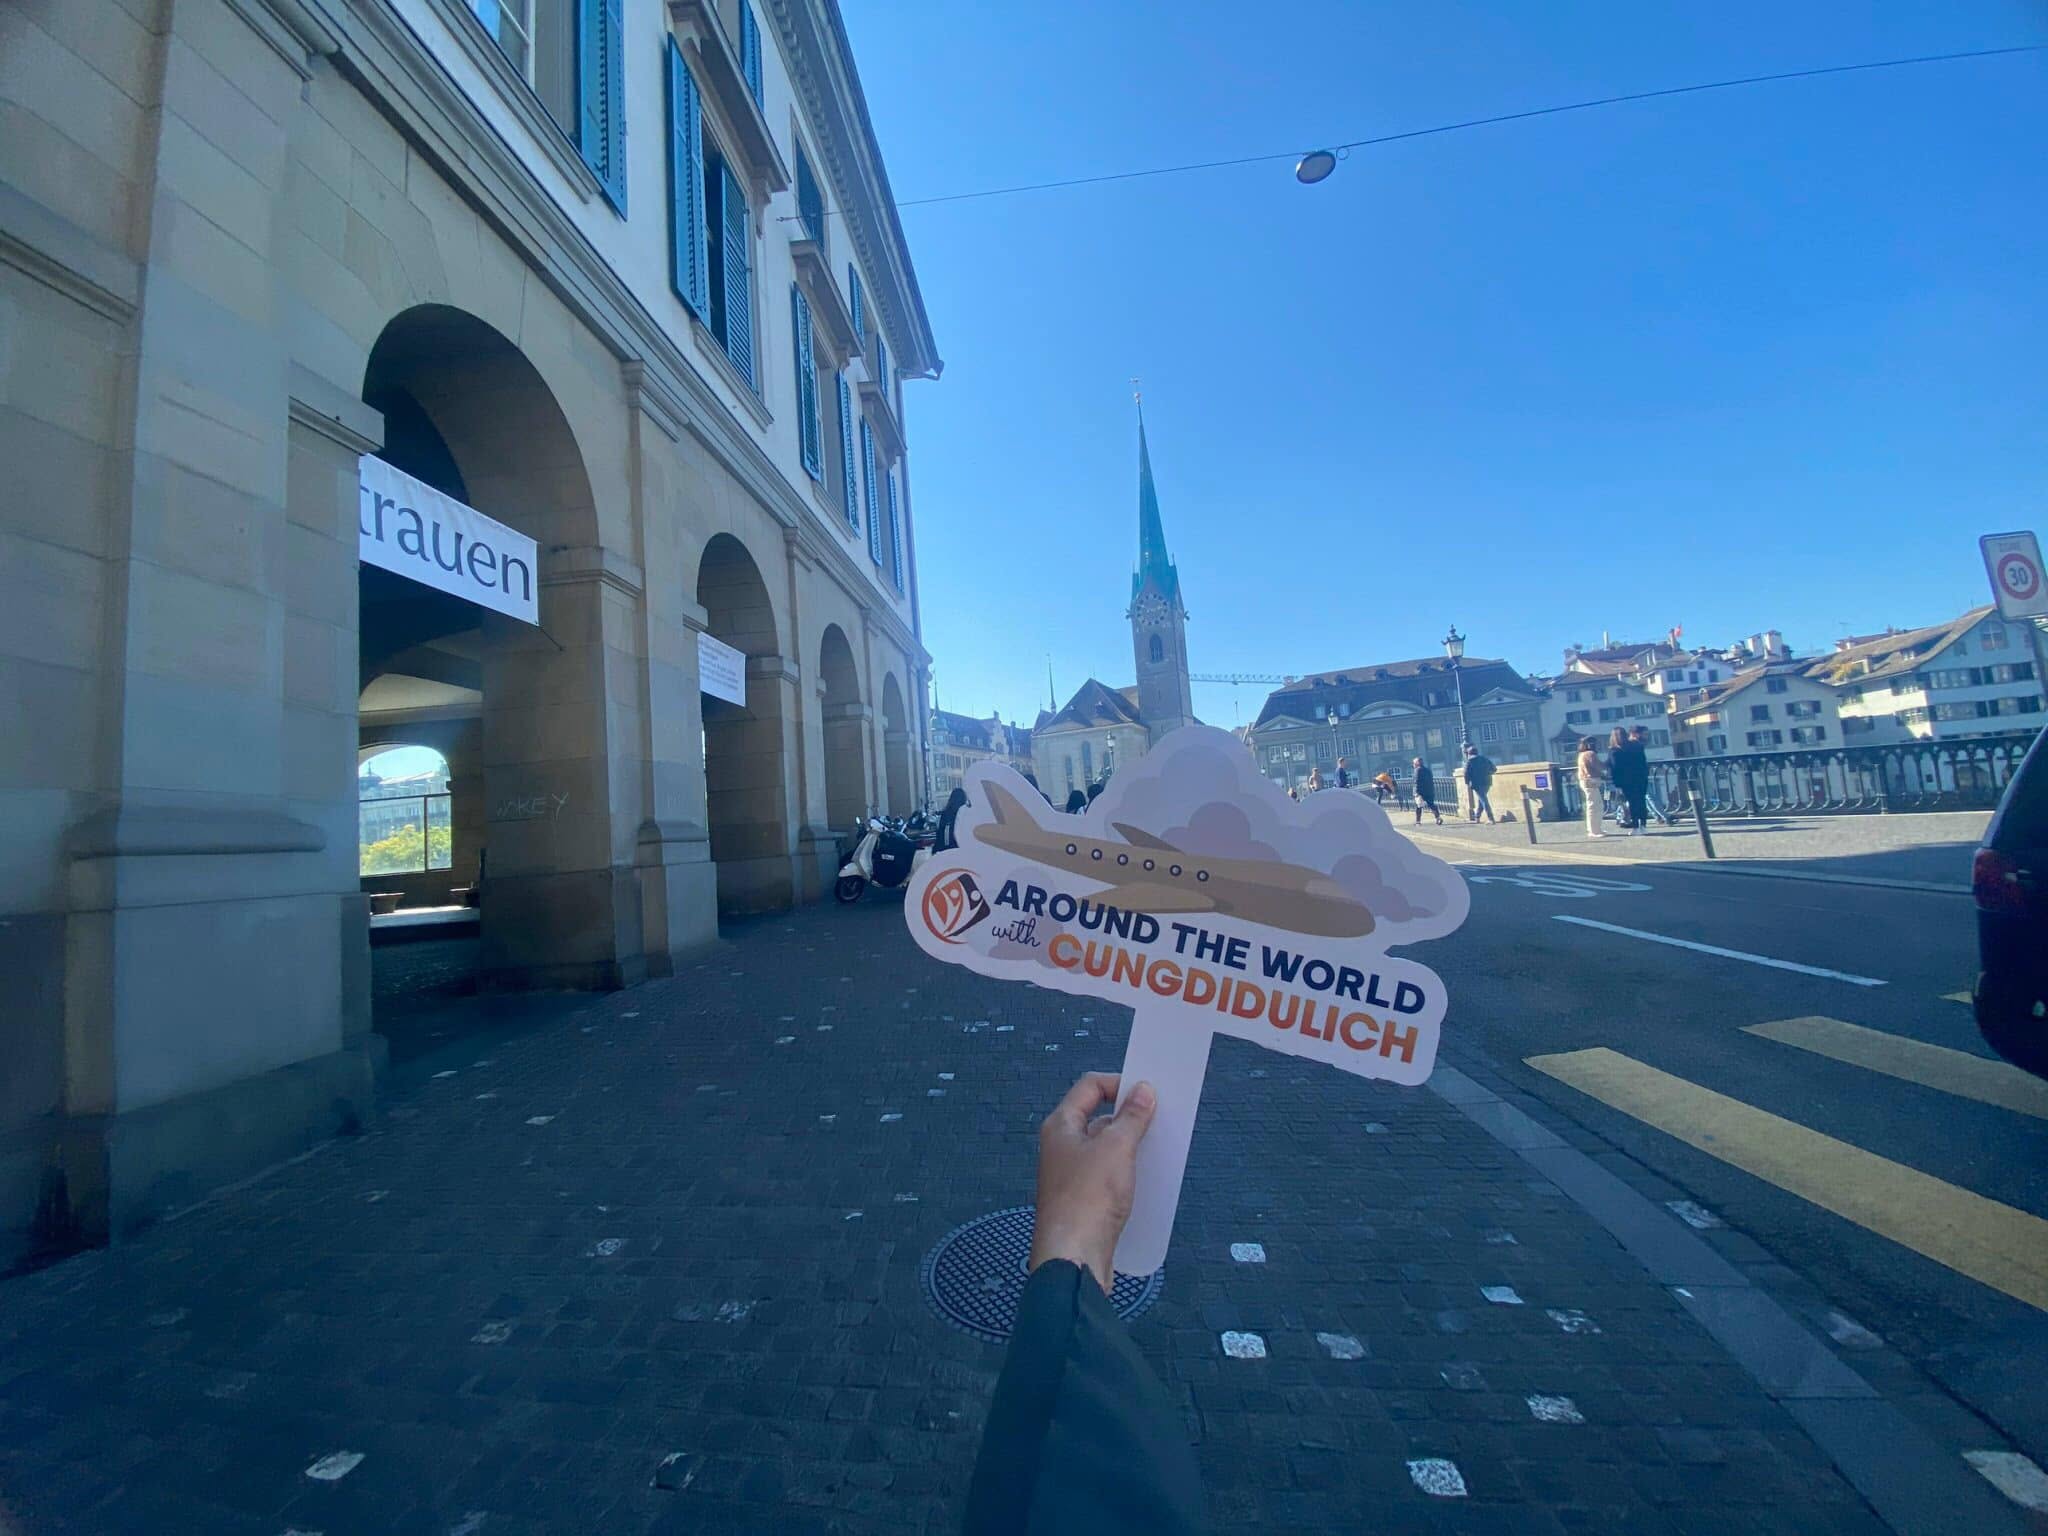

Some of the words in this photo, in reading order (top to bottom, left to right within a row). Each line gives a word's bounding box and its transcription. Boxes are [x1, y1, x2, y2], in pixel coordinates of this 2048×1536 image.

[2008, 567, 2028, 586] 30
[991, 917, 1041, 948] with
[1048, 933, 1418, 1063] CUNGDIDULICH
[993, 879, 1160, 944] AROUND
[1171, 922, 1251, 971] THE
[1262, 945, 1426, 1015] WORLD
